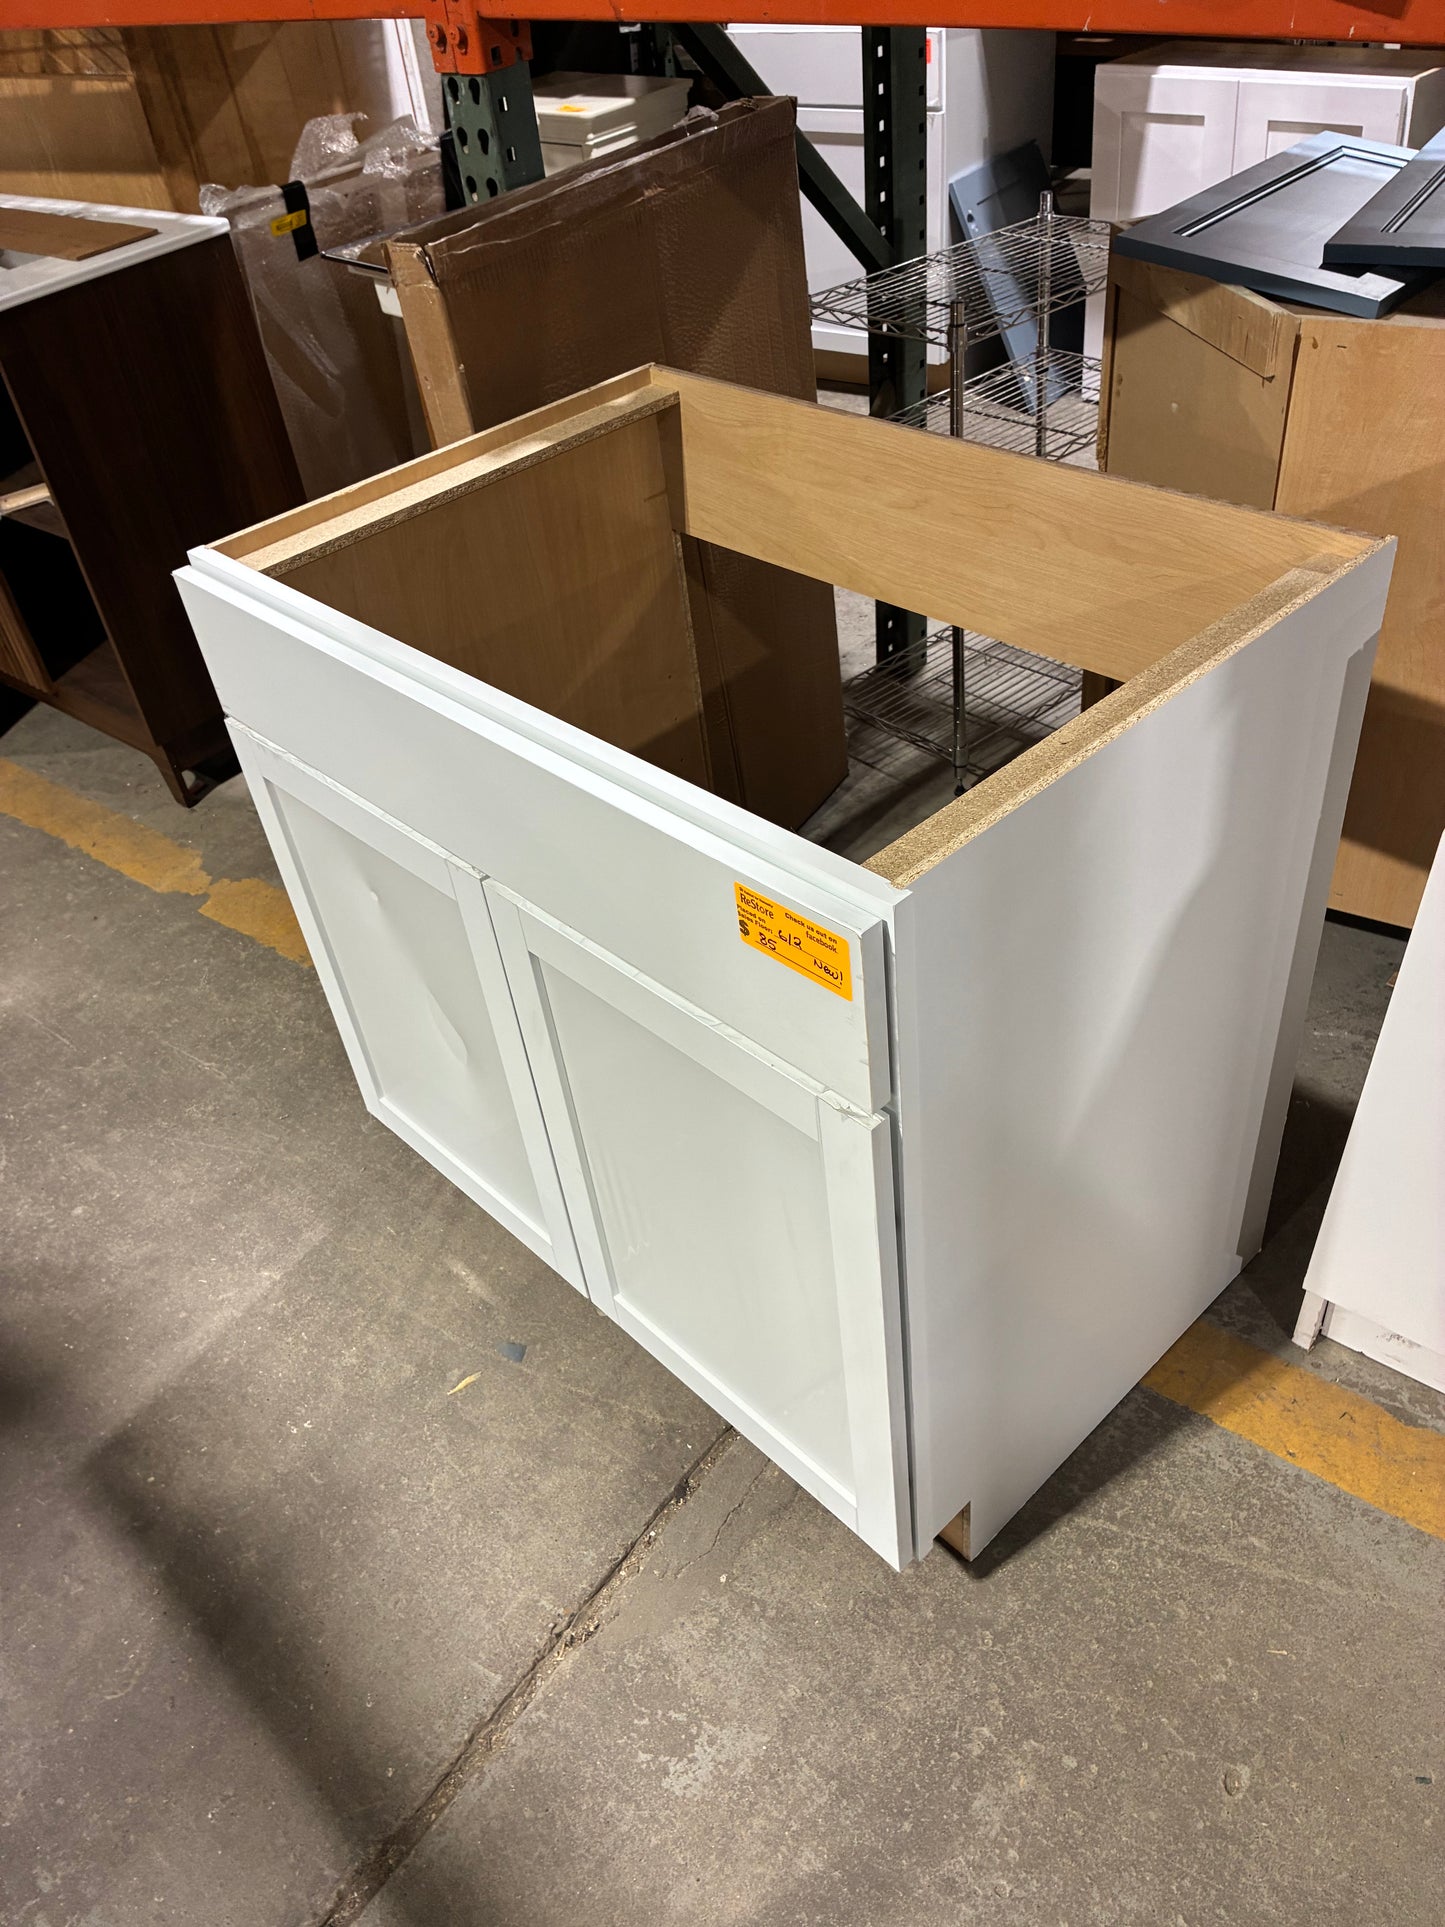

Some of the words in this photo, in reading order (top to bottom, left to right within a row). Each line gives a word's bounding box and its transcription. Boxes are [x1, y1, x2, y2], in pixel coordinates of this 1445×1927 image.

[740, 892, 774, 919] ReStore
[739, 919, 750, 936] $
[784, 912, 805, 927] Check
[816, 930, 828, 939] out
[813, 958, 843, 986] New!
